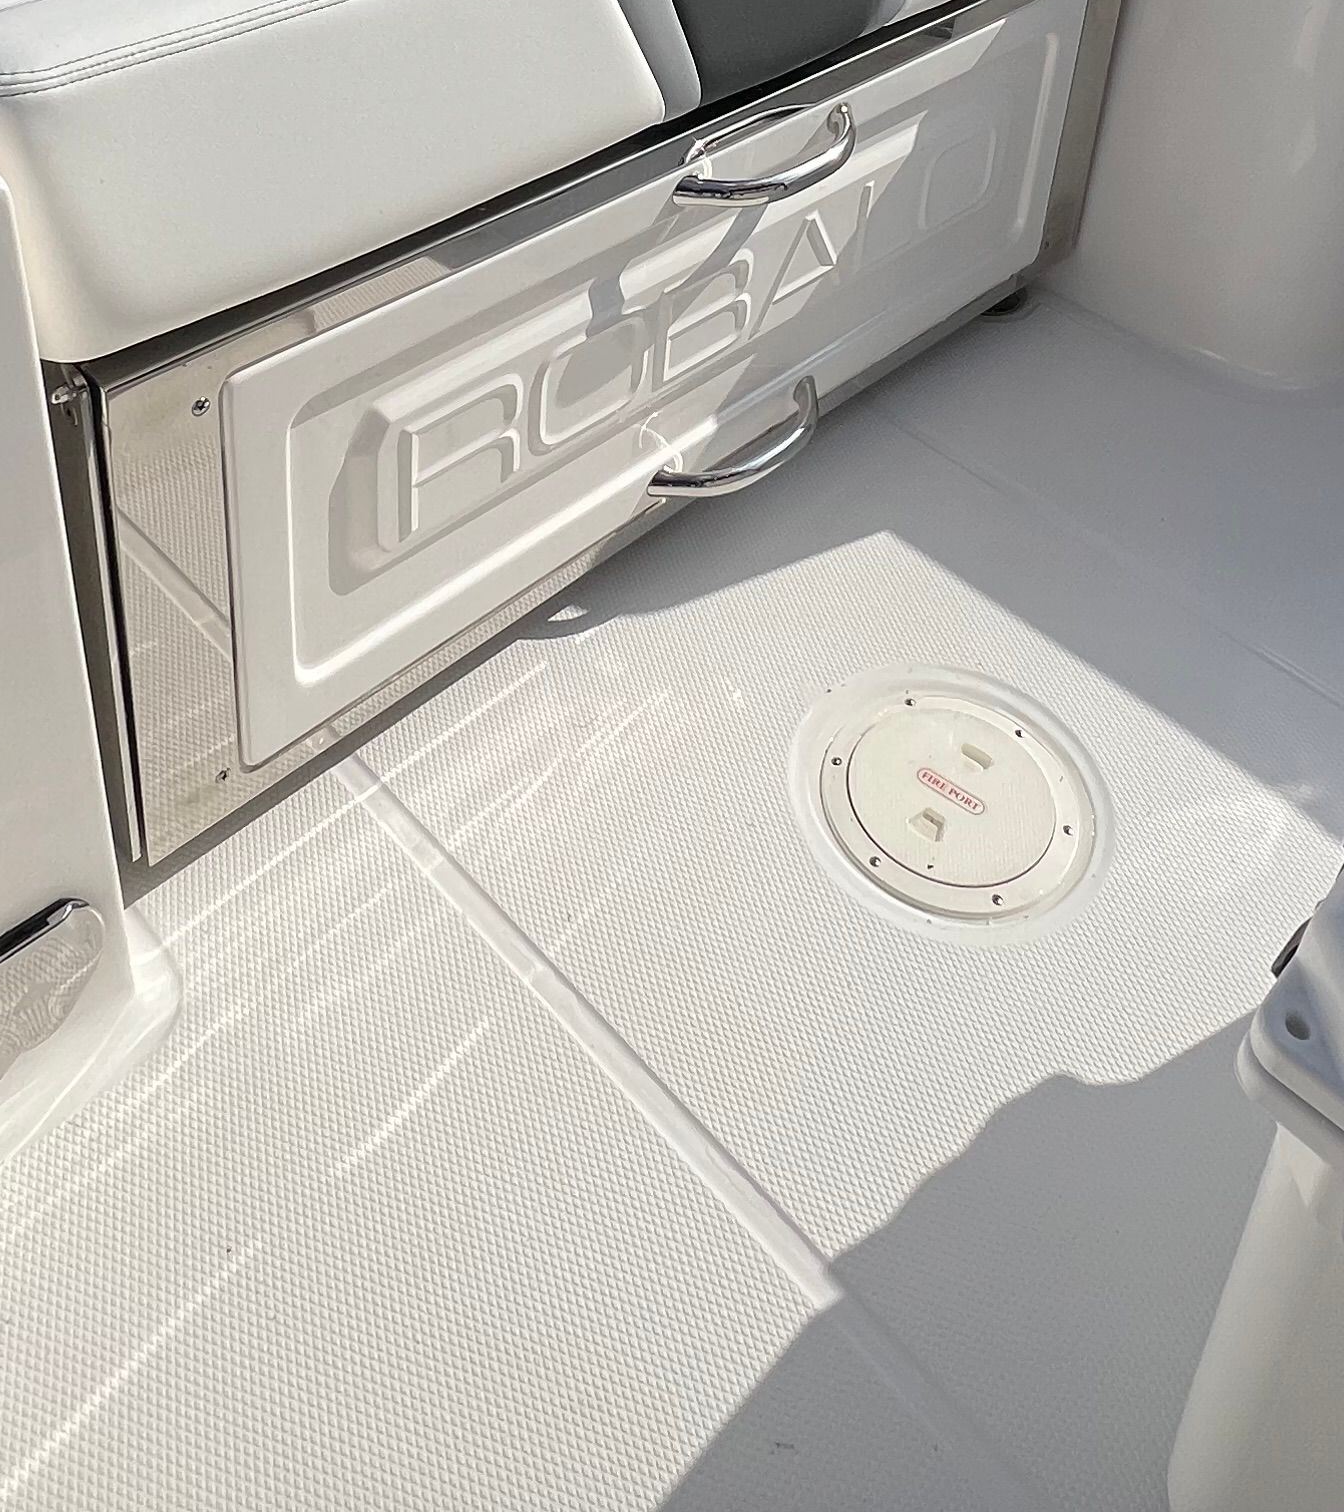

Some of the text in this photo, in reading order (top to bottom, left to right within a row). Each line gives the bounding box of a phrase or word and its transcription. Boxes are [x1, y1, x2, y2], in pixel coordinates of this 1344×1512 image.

[397, 125, 1001, 544] ROBALO
[921, 771, 982, 810] FIRE PORT
